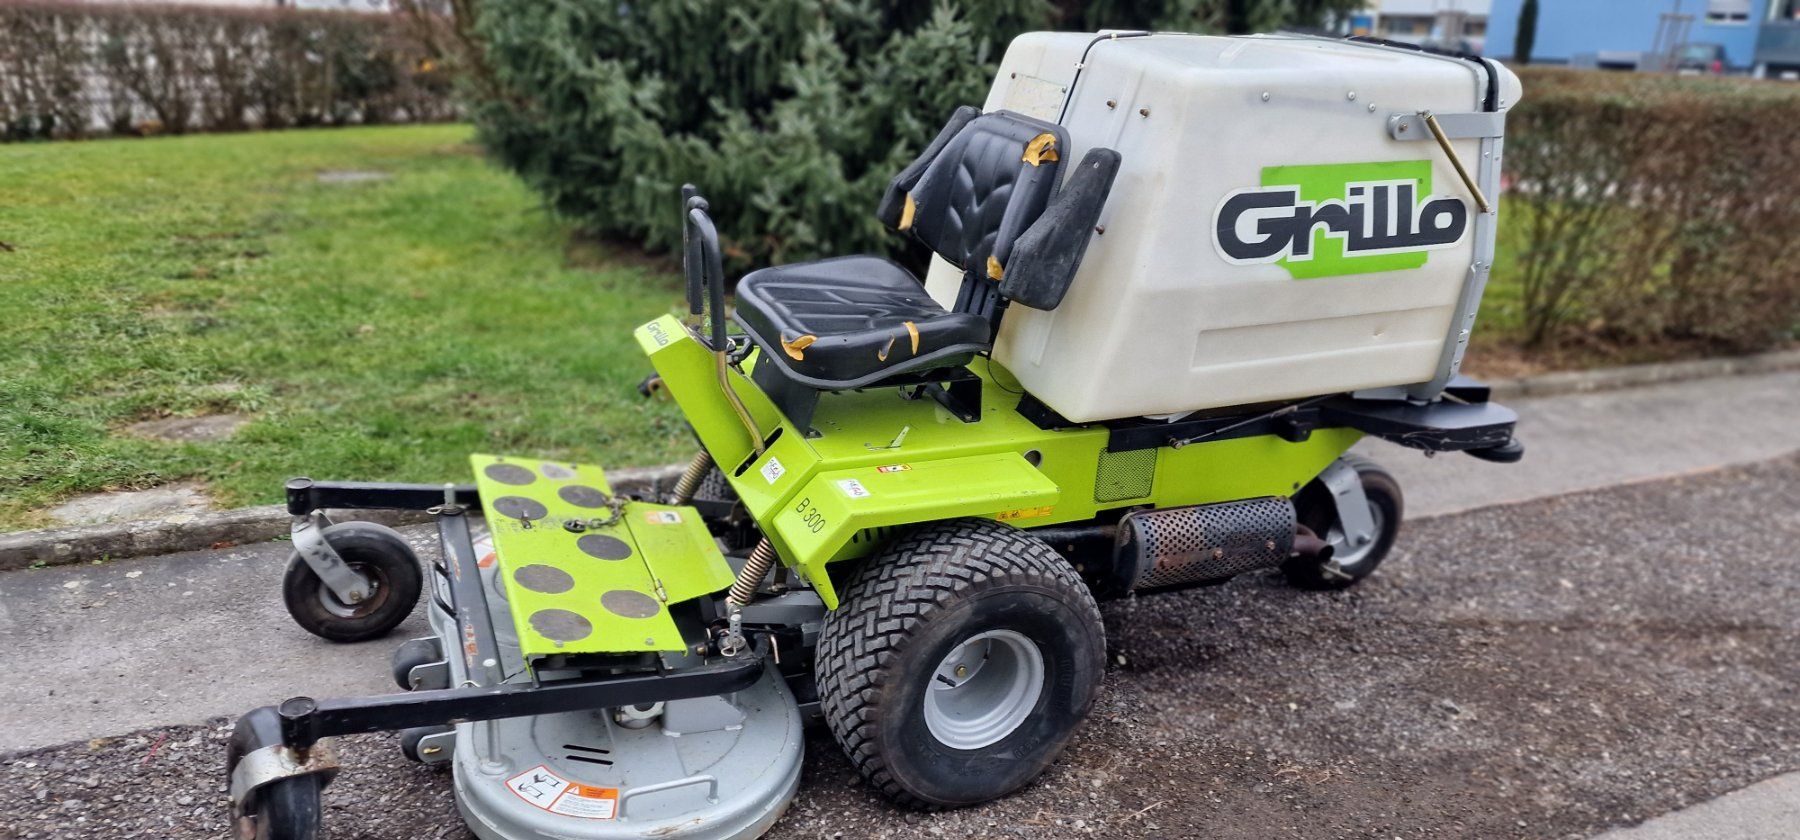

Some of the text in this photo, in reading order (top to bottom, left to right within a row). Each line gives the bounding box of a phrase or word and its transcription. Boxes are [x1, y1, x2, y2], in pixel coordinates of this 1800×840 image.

[1217, 184, 1467, 259] Grillo
[647, 321, 669, 347] Grillo
[796, 497, 826, 534] B 300
